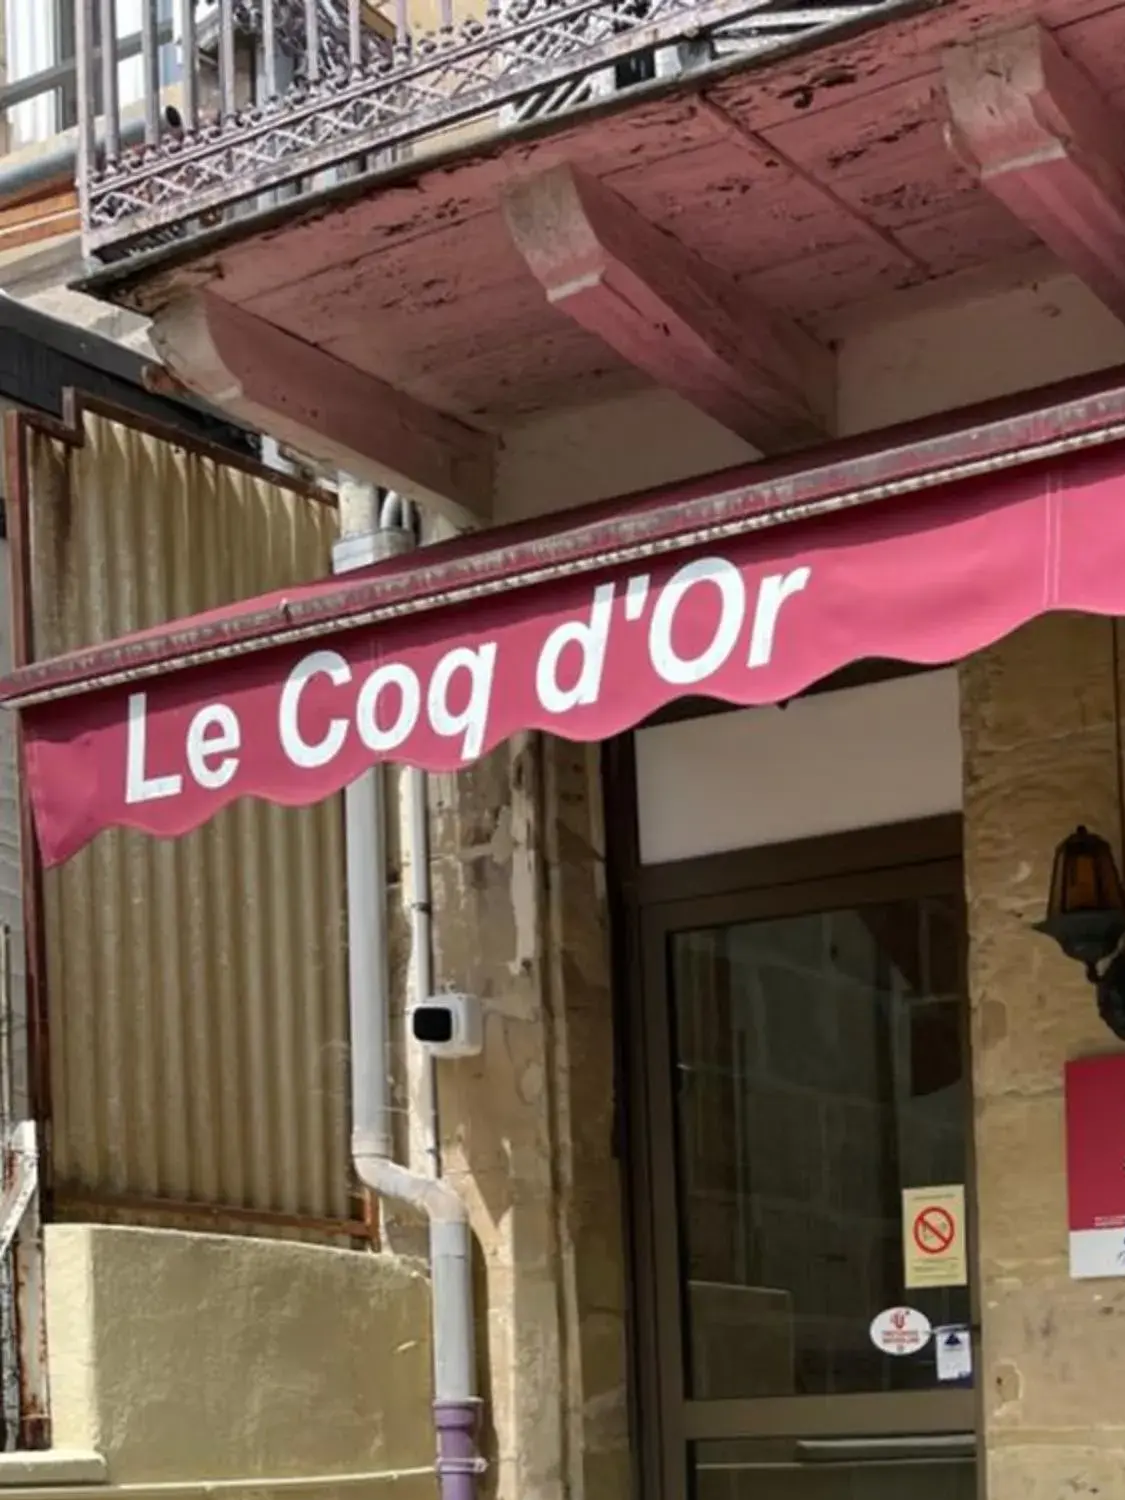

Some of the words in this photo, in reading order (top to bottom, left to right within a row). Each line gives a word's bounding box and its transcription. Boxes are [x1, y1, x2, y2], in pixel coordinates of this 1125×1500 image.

[124, 692, 241, 805] Le
[278, 640, 498, 769] Coq
[535, 556, 812, 714] d'Or
